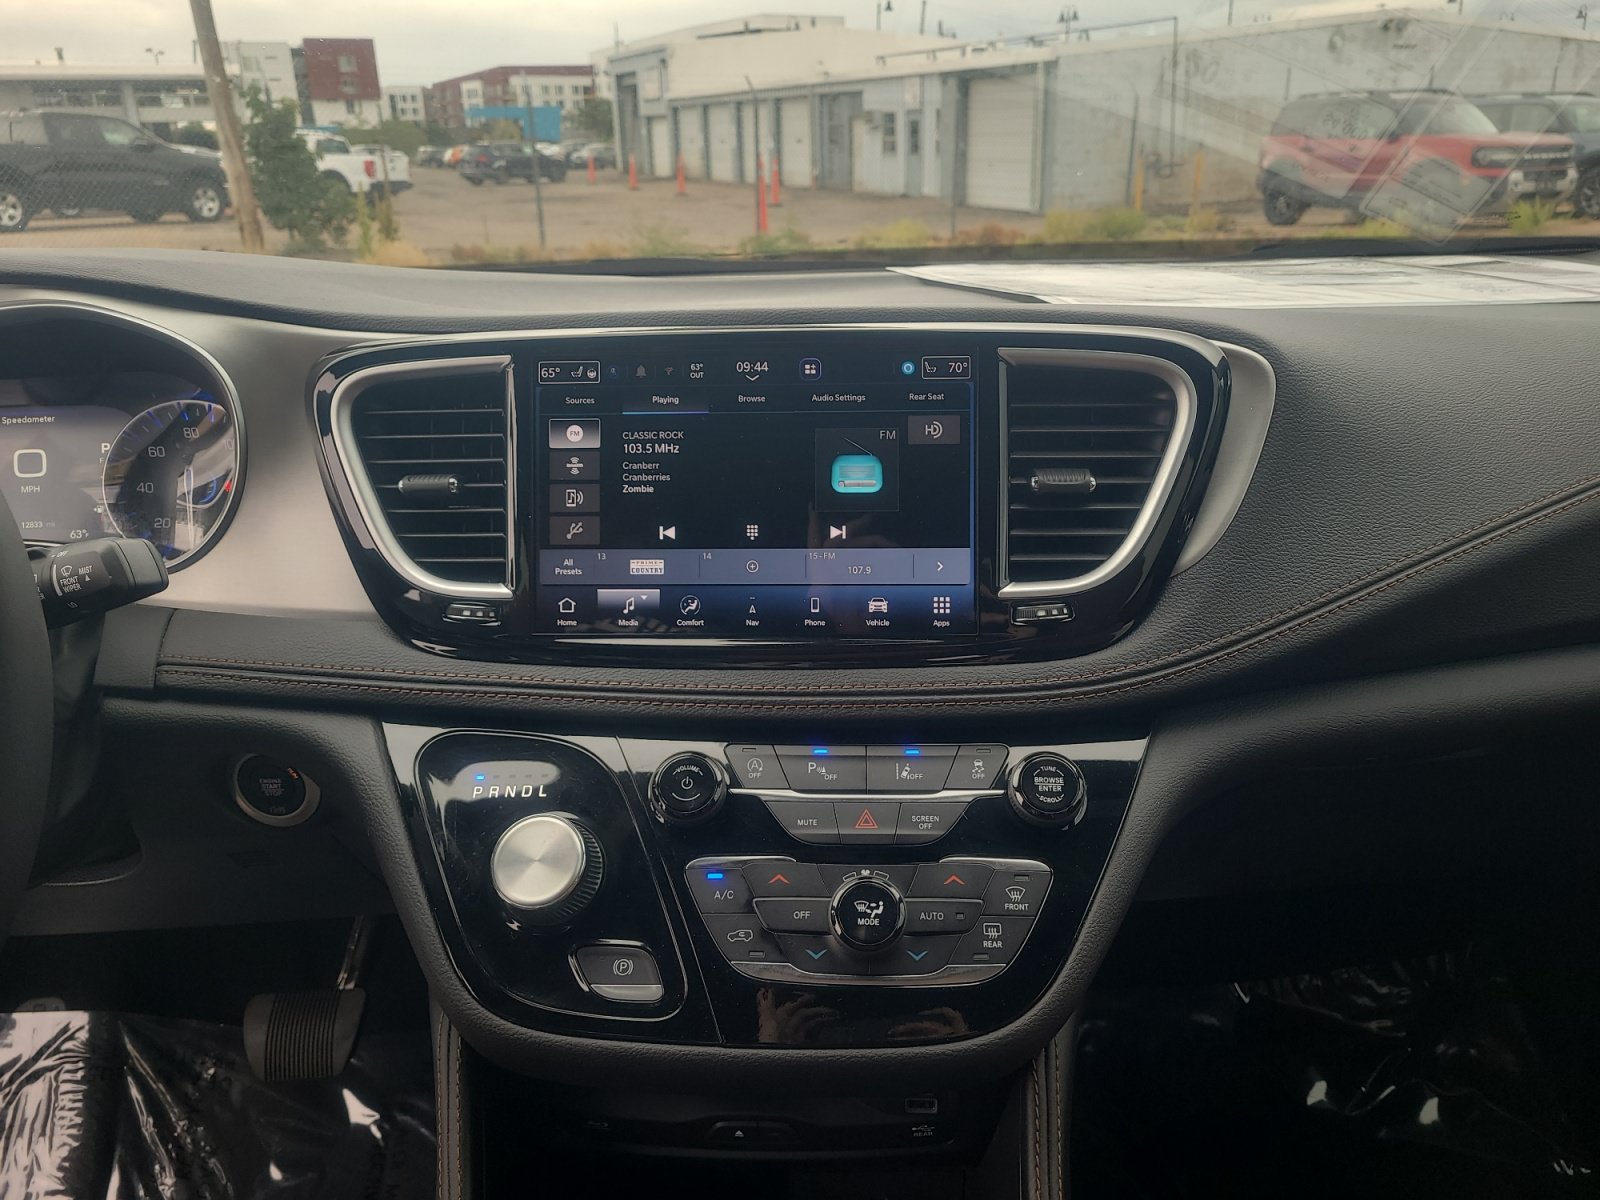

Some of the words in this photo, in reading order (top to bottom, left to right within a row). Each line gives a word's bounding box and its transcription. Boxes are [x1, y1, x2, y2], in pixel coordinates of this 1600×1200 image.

[690, 363, 703, 371] 63°
[736, 361, 769, 373] 09:44
[948, 362, 968, 373] 70°
[541, 368, 560, 378] 65°
[652, 395, 680, 405] Playing
[738, 394, 766, 403] Browse
[811, 393, 834, 402] Audio
[834, 393, 866, 403] Settings
[908, 392, 926, 400] Rear
[927, 392, 945, 400] Seat
[565, 397, 595, 405] Sources
[1, 415, 56, 425] Speedometer
[183, 427, 200, 438] 80
[622, 431, 657, 440] CLASSIC
[659, 430, 684, 439] ROCK
[879, 430, 896, 440] FM
[101, 442, 111, 454] P
[148, 446, 165, 458] 60
[623, 444, 653, 454] 103.5
[654, 443, 680, 454] MHz
[622, 461, 660, 470] Cranberr
[622, 473, 671, 481] Cranberries
[20, 485, 41, 494] MPH
[136, 482, 154, 494] 40
[622, 485, 655, 493] Zombie
[21, 520, 43, 529] 12833
[154, 517, 171, 529] 20
[563, 558, 574, 566] All
[78, 565, 93, 576] MIST
[555, 567, 583, 576] Presets
[848, 566, 872, 575] 107.9
[60, 575, 79, 586] FRONT
[62, 583, 83, 594] WIPER
[676, 619, 704, 627] Comfort
[745, 619, 760, 627] Nav
[804, 619, 826, 627] Phone
[865, 619, 890, 627] Vehicle
[932, 619, 951, 628] Apps
[675, 764, 701, 774] VOLUME
[1040, 765, 1057, 773] TUNE
[1034, 776, 1065, 784] BROWSE
[1038, 794, 1063, 804] SCROLL
[911, 815, 940, 823] SCREEN
[714, 890, 734, 899] A/C
[1004, 903, 1029, 911] FRONT
[793, 911, 812, 920] OFF
[919, 912, 944, 921] AUTO
[857, 918, 880, 926] MODE
[983, 940, 1003, 949] REAR
